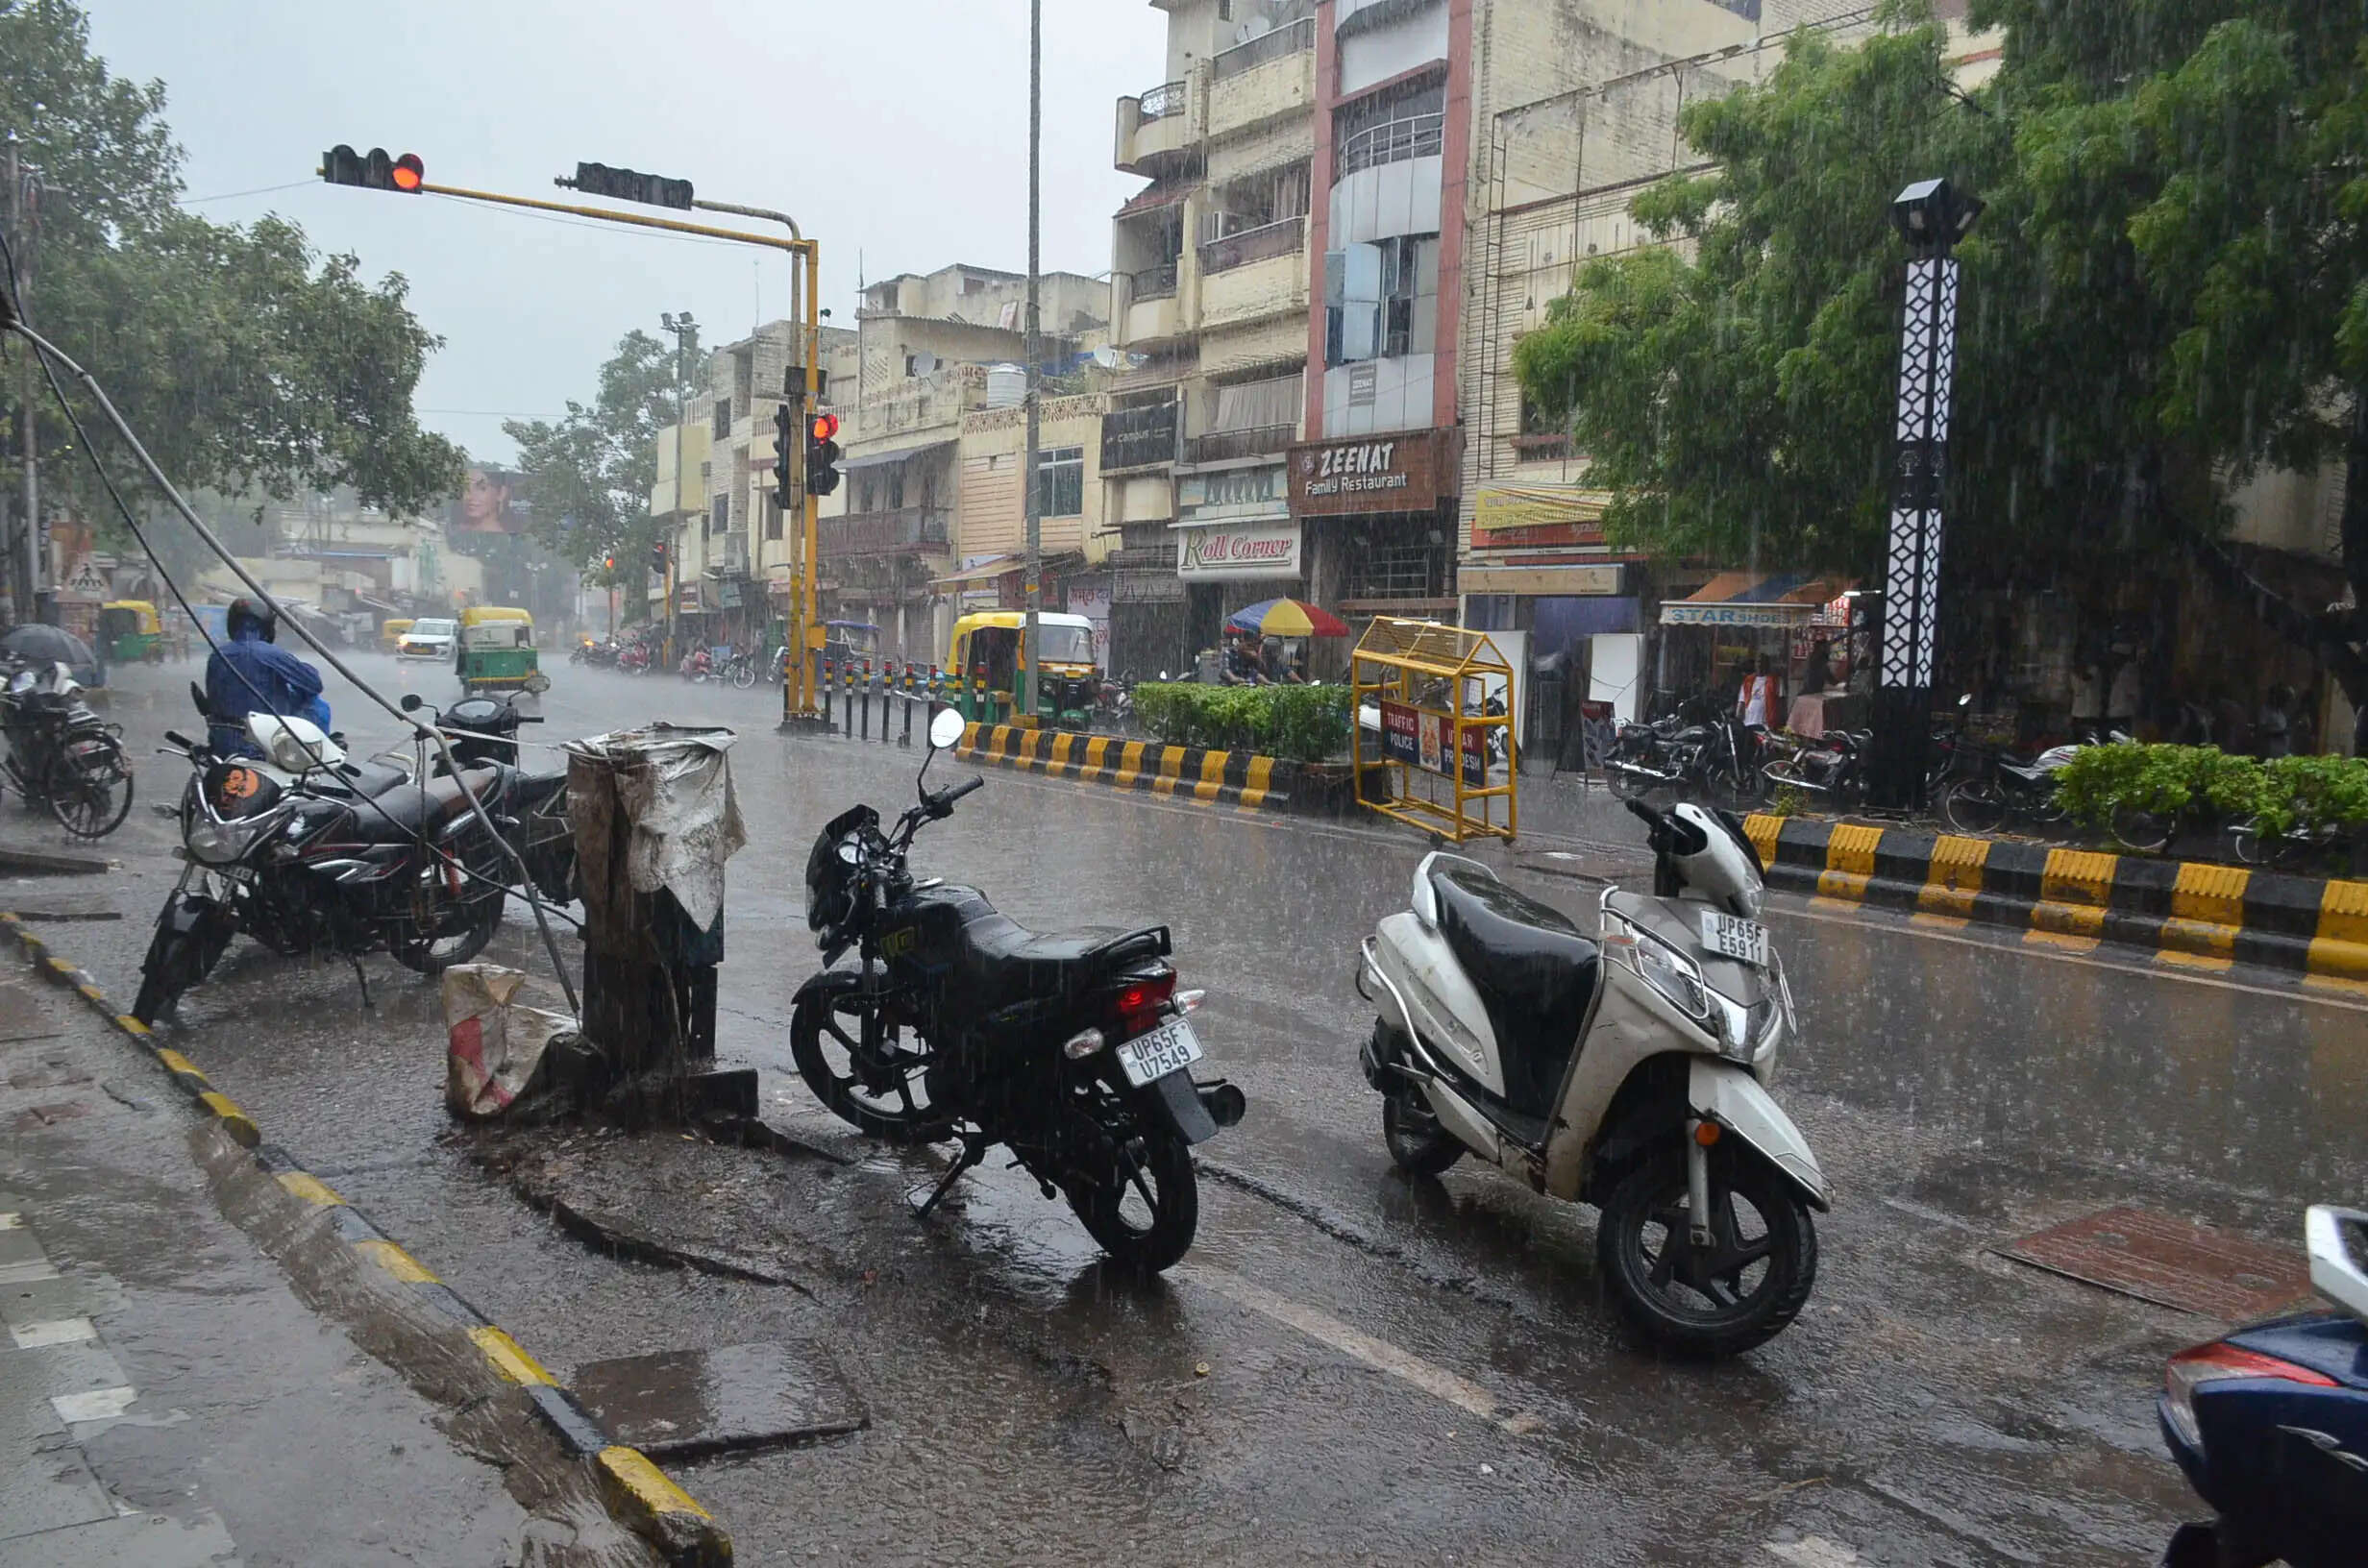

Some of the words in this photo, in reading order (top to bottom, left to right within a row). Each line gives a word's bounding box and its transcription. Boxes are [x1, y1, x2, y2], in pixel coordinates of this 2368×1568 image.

[1320, 443, 1394, 477] ZEENAT
[1305, 478, 1338, 496] Family
[1341, 472, 1407, 492] Restaurant
[1180, 529, 1229, 569] Roll
[1231, 536, 1292, 559] Corner
[1670, 609, 1734, 623] STAR
[1387, 712, 1415, 731] TRAFFIC
[1390, 730, 1415, 751] POLICE
[1447, 729, 1473, 748] UAR
[1717, 915, 1763, 943] UP65F
[1719, 934, 1762, 962] E5911
[1131, 1027, 1179, 1061] UP65F
[1139, 1045, 1191, 1078] U7549
